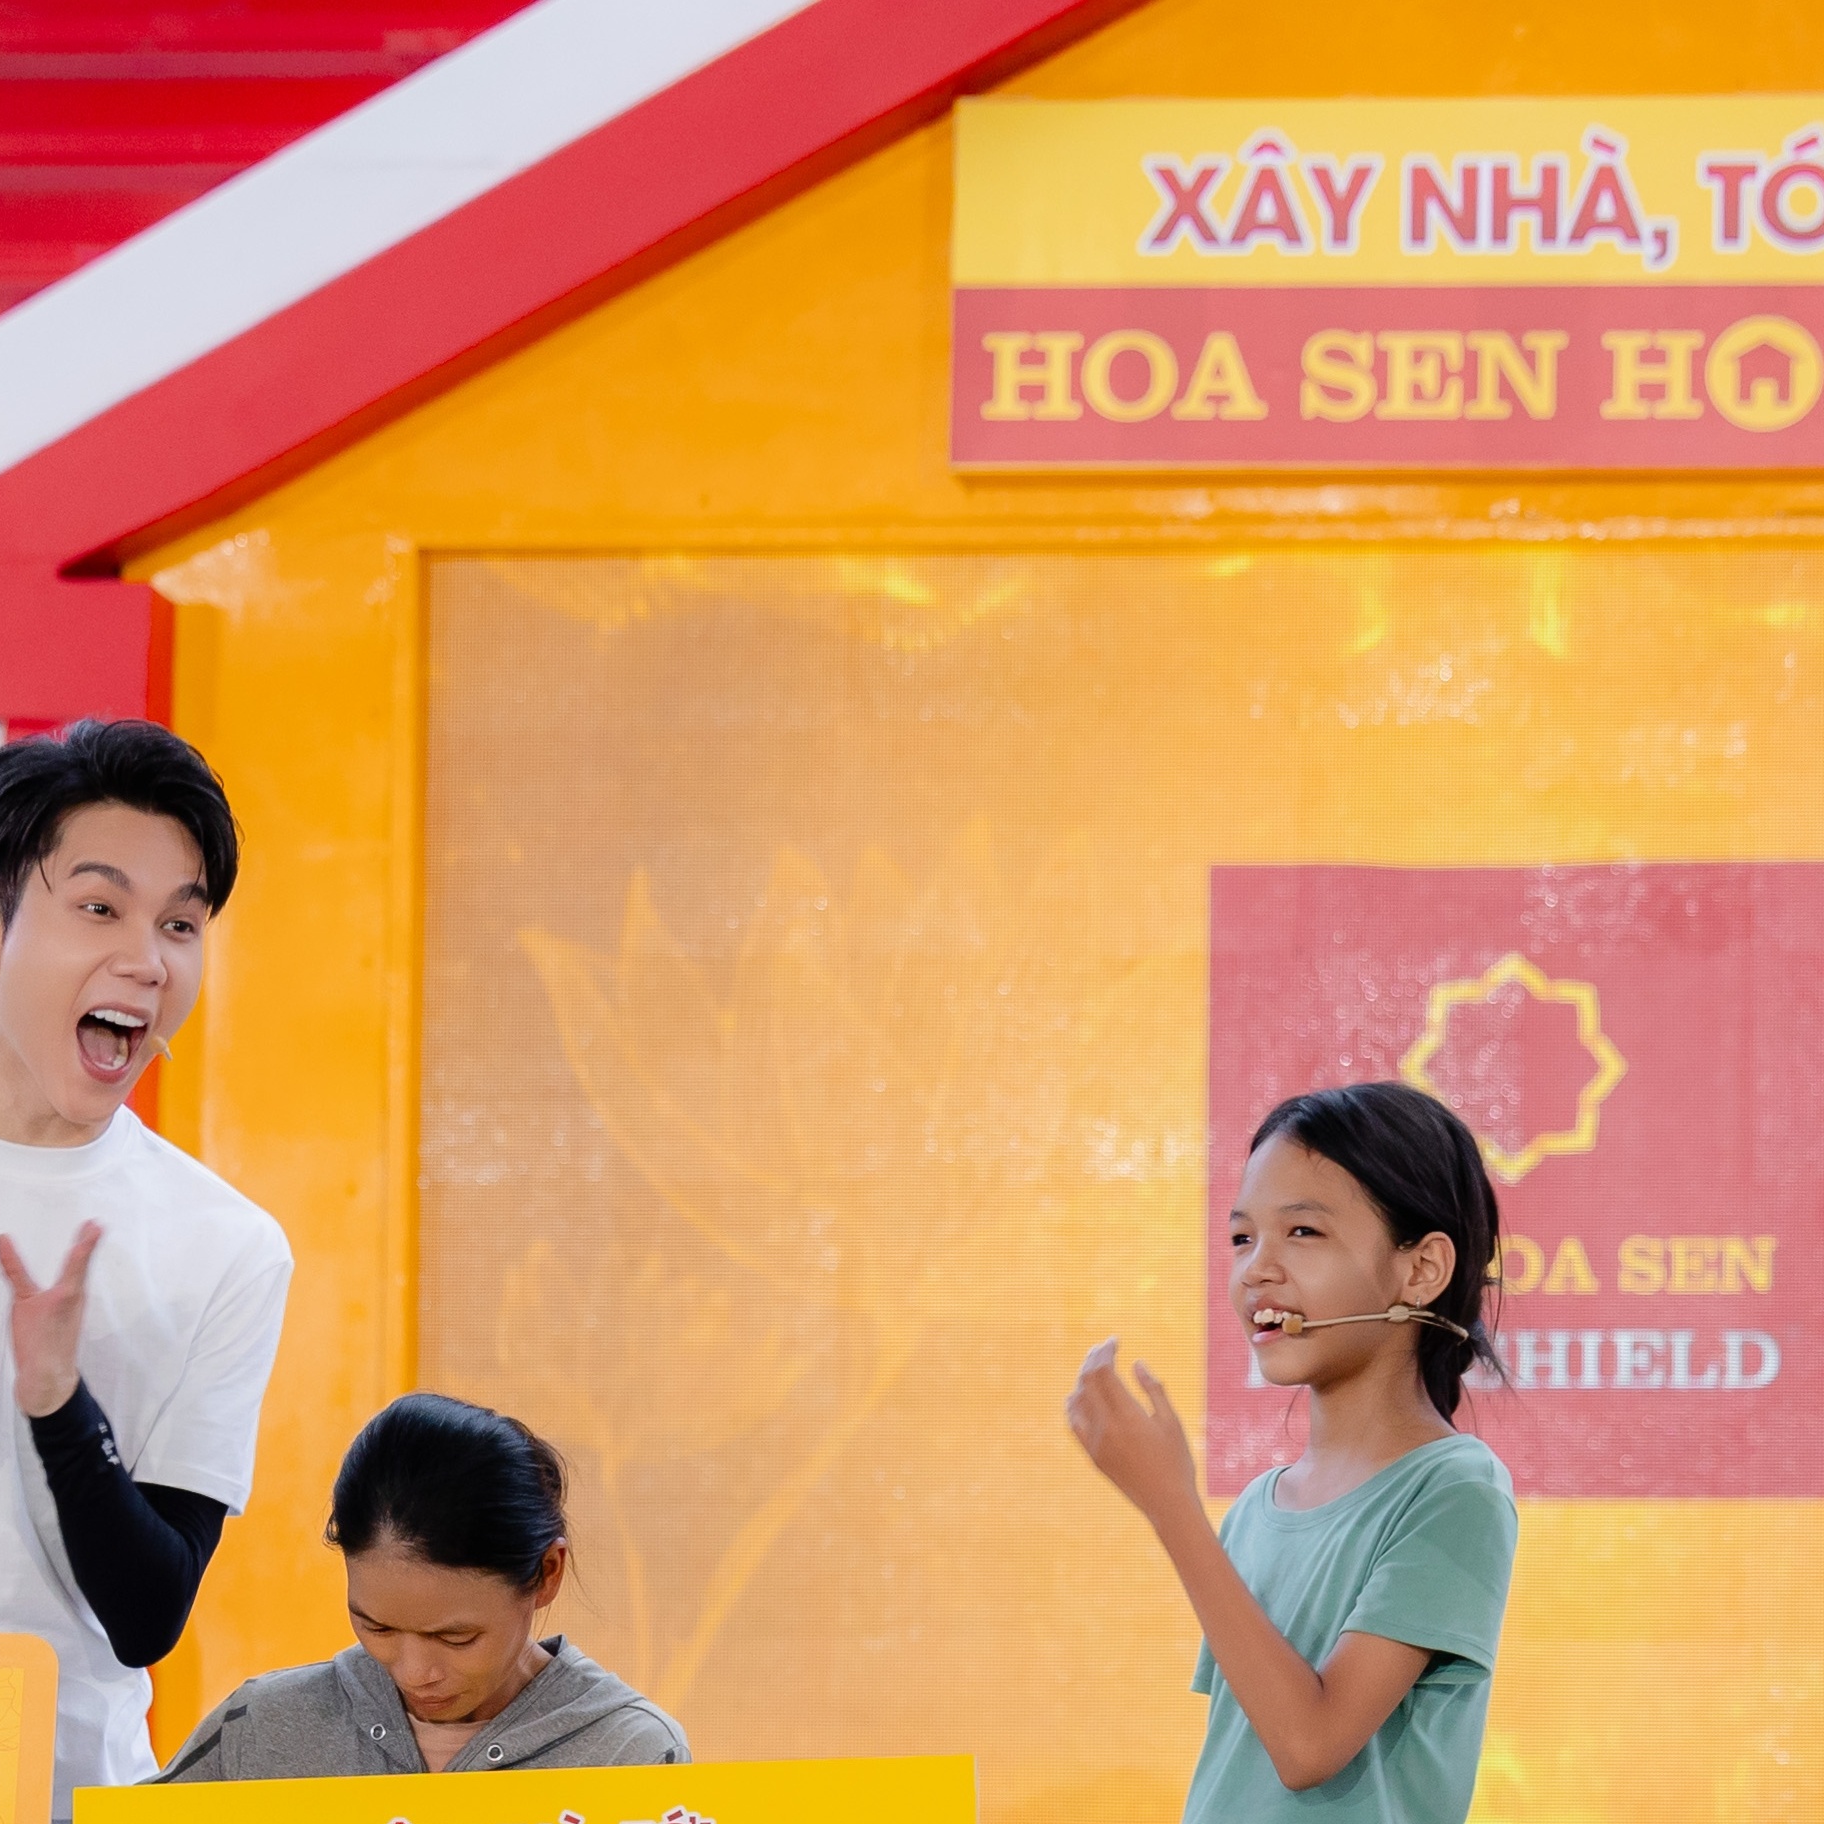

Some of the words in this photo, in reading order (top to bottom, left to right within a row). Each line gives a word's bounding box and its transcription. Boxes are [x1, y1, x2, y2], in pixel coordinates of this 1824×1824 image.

[1142, 130, 1382, 256] XÂY
[1400, 126, 1678, 274] NHÀ,
[980, 328, 1268, 424] HOA
[1296, 328, 1571, 424] SEN
[1616, 1234, 1778, 1294] SEN
